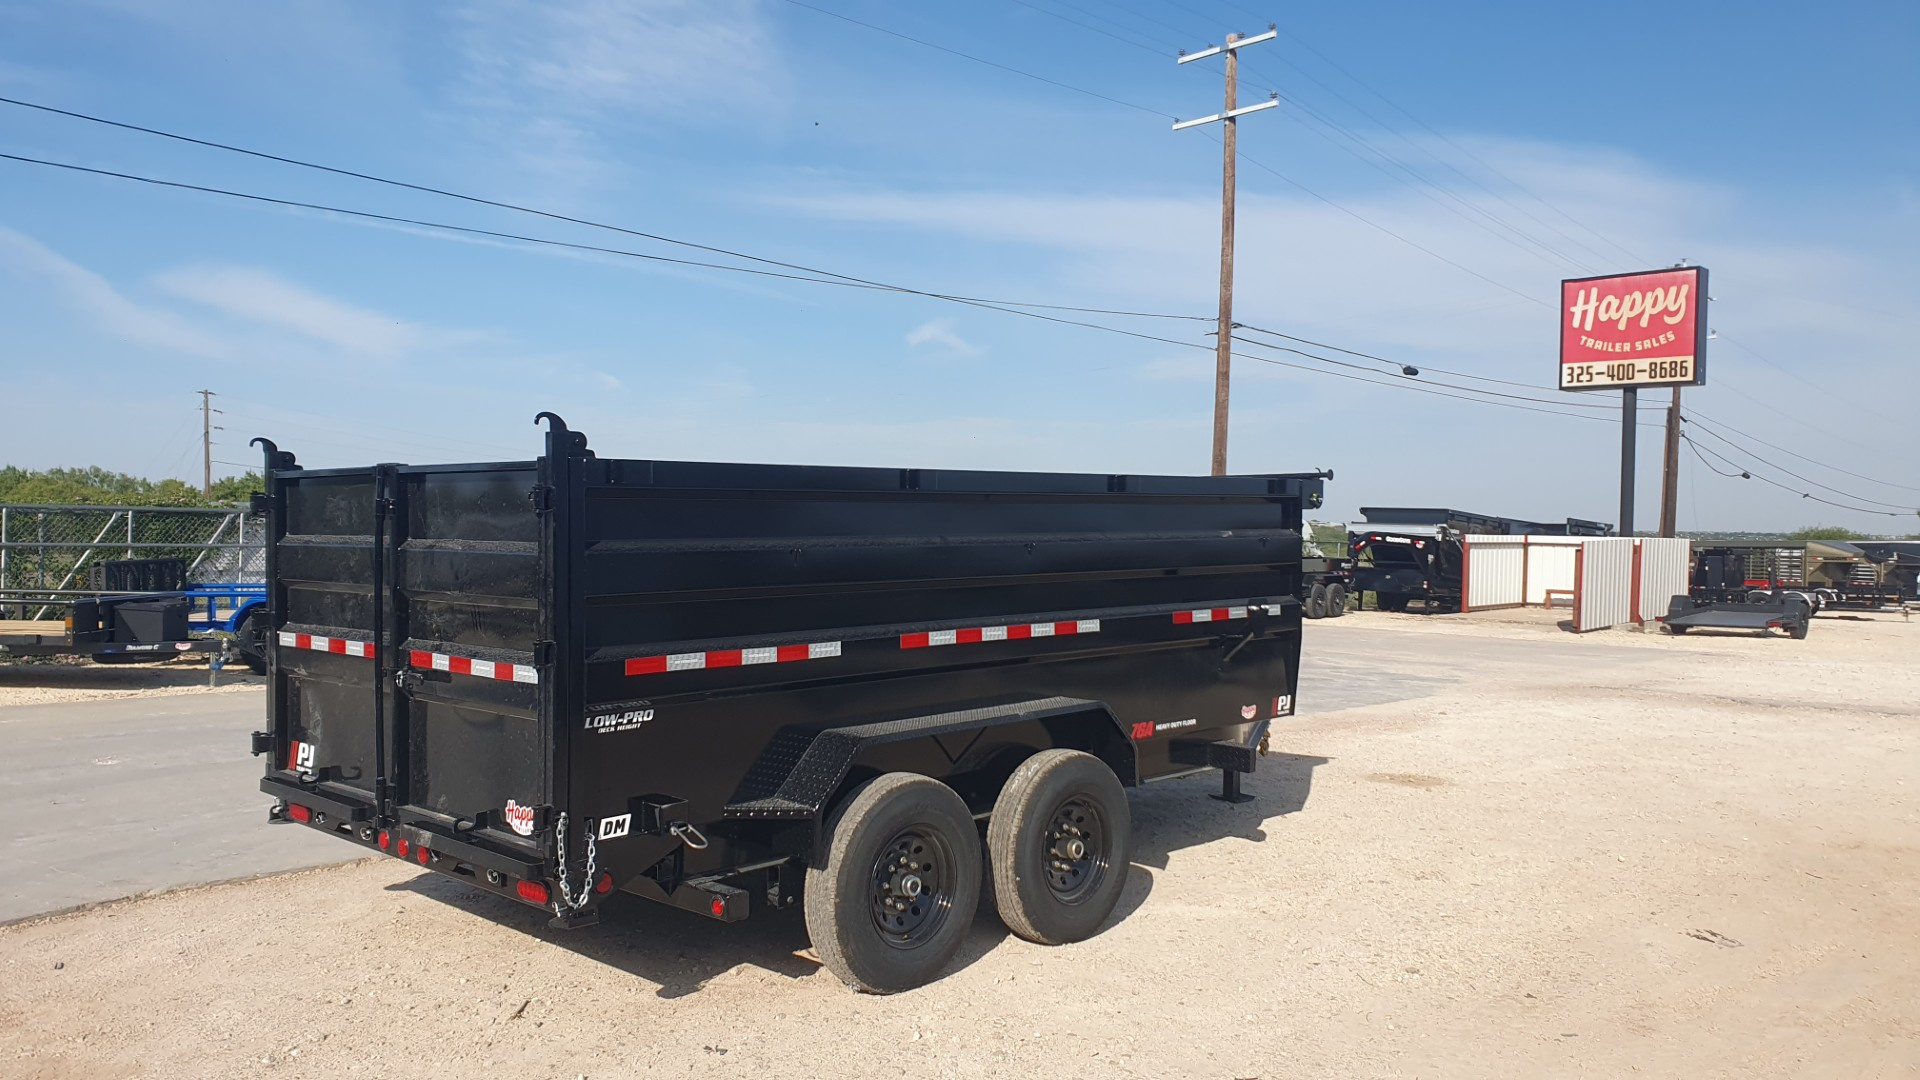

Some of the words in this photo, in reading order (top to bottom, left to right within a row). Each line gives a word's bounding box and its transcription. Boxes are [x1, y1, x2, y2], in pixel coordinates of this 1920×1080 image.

[1569, 284, 1690, 332] Happy
[1580, 335, 1631, 352] TRAILER
[1635, 330, 1676, 351] SALES
[1566, 360, 1689, 384] 325-400-8686
[1277, 694, 1291, 711] PJ
[584, 709, 654, 729] LOW-PRO
[617, 723, 641, 731] HEIGHT
[1155, 723, 1170, 732] HEAVY
[1170, 720, 1182, 729] DUTY
[1182, 718, 1197, 727] FLOOR
[297, 742, 315, 768] PJ
[506, 801, 534, 826] Happ
[603, 817, 627, 836] DM
